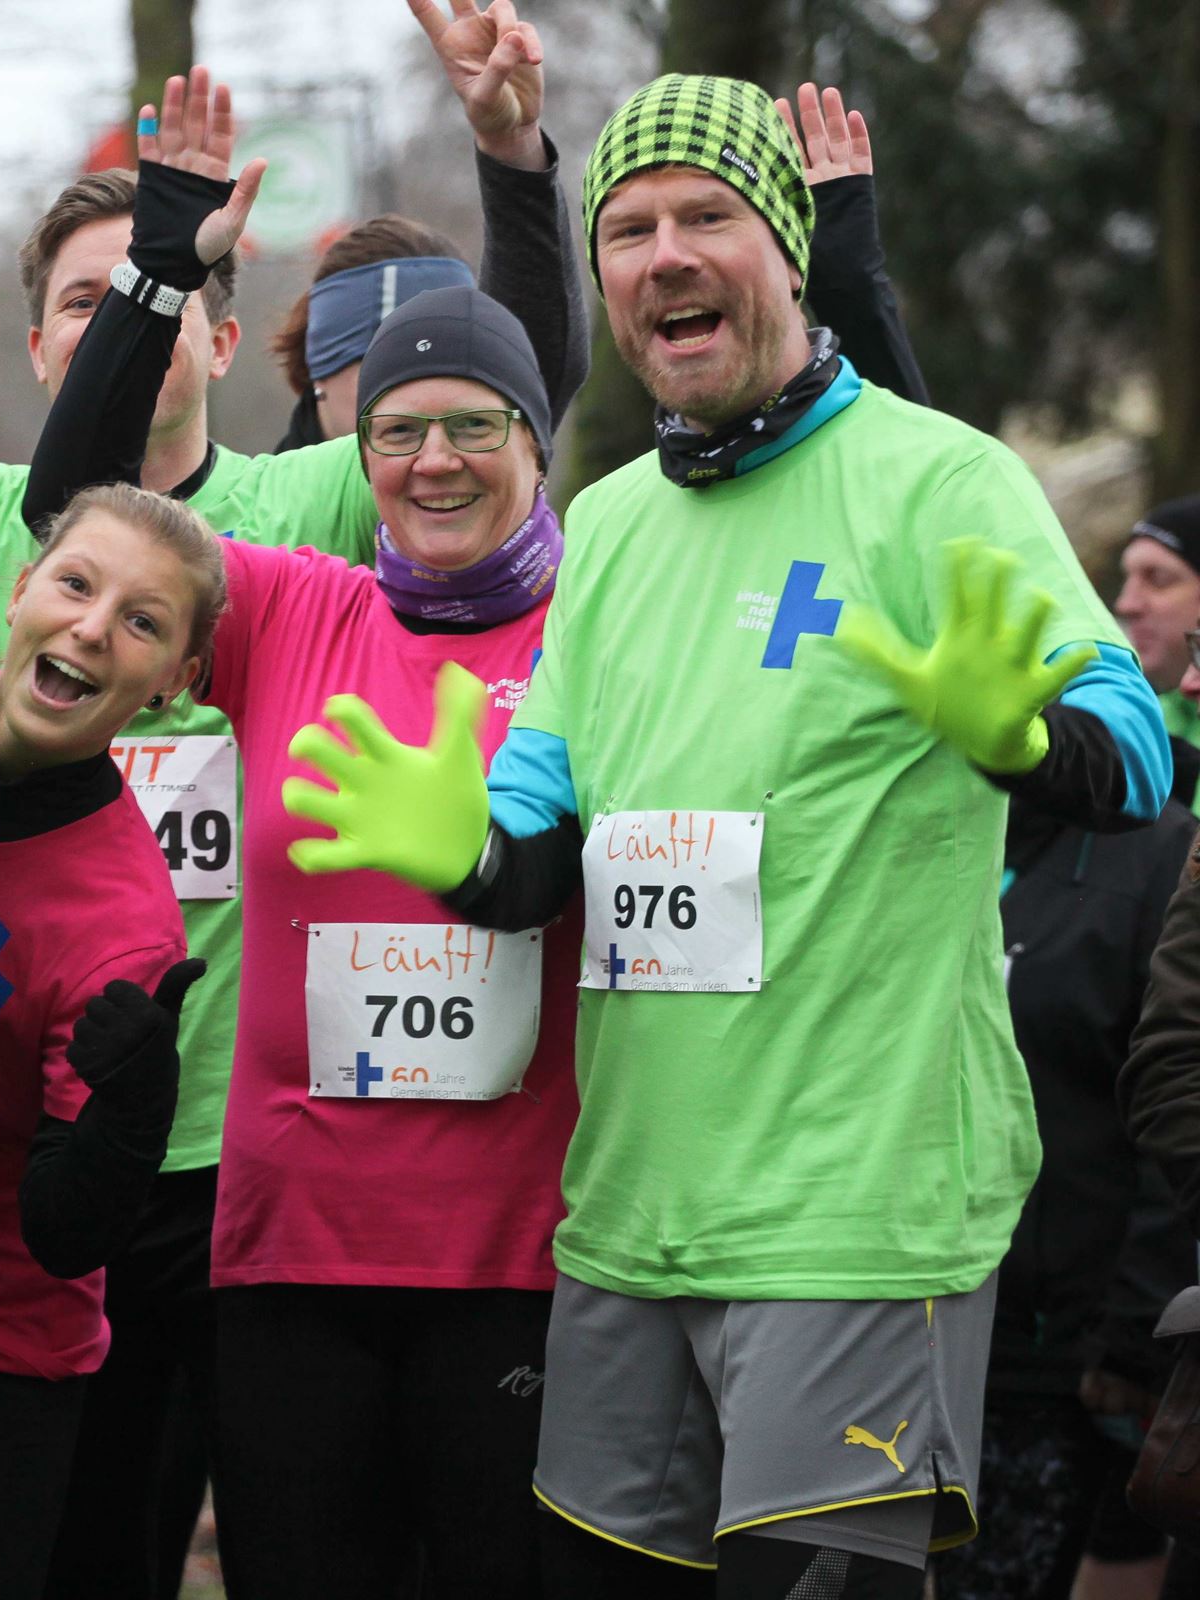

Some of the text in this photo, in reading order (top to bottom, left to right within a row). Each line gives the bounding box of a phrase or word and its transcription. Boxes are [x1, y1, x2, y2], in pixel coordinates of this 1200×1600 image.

[509, 540, 545, 575] LAUFEN
[607, 812, 716, 871] Läuft!
[614, 884, 697, 930] 976
[351, 926, 495, 983] Läuft!
[365, 995, 474, 1039] 706
[390, 1086, 463, 1099] Gemeinsam
[433, 1072, 466, 1084] Jahre
